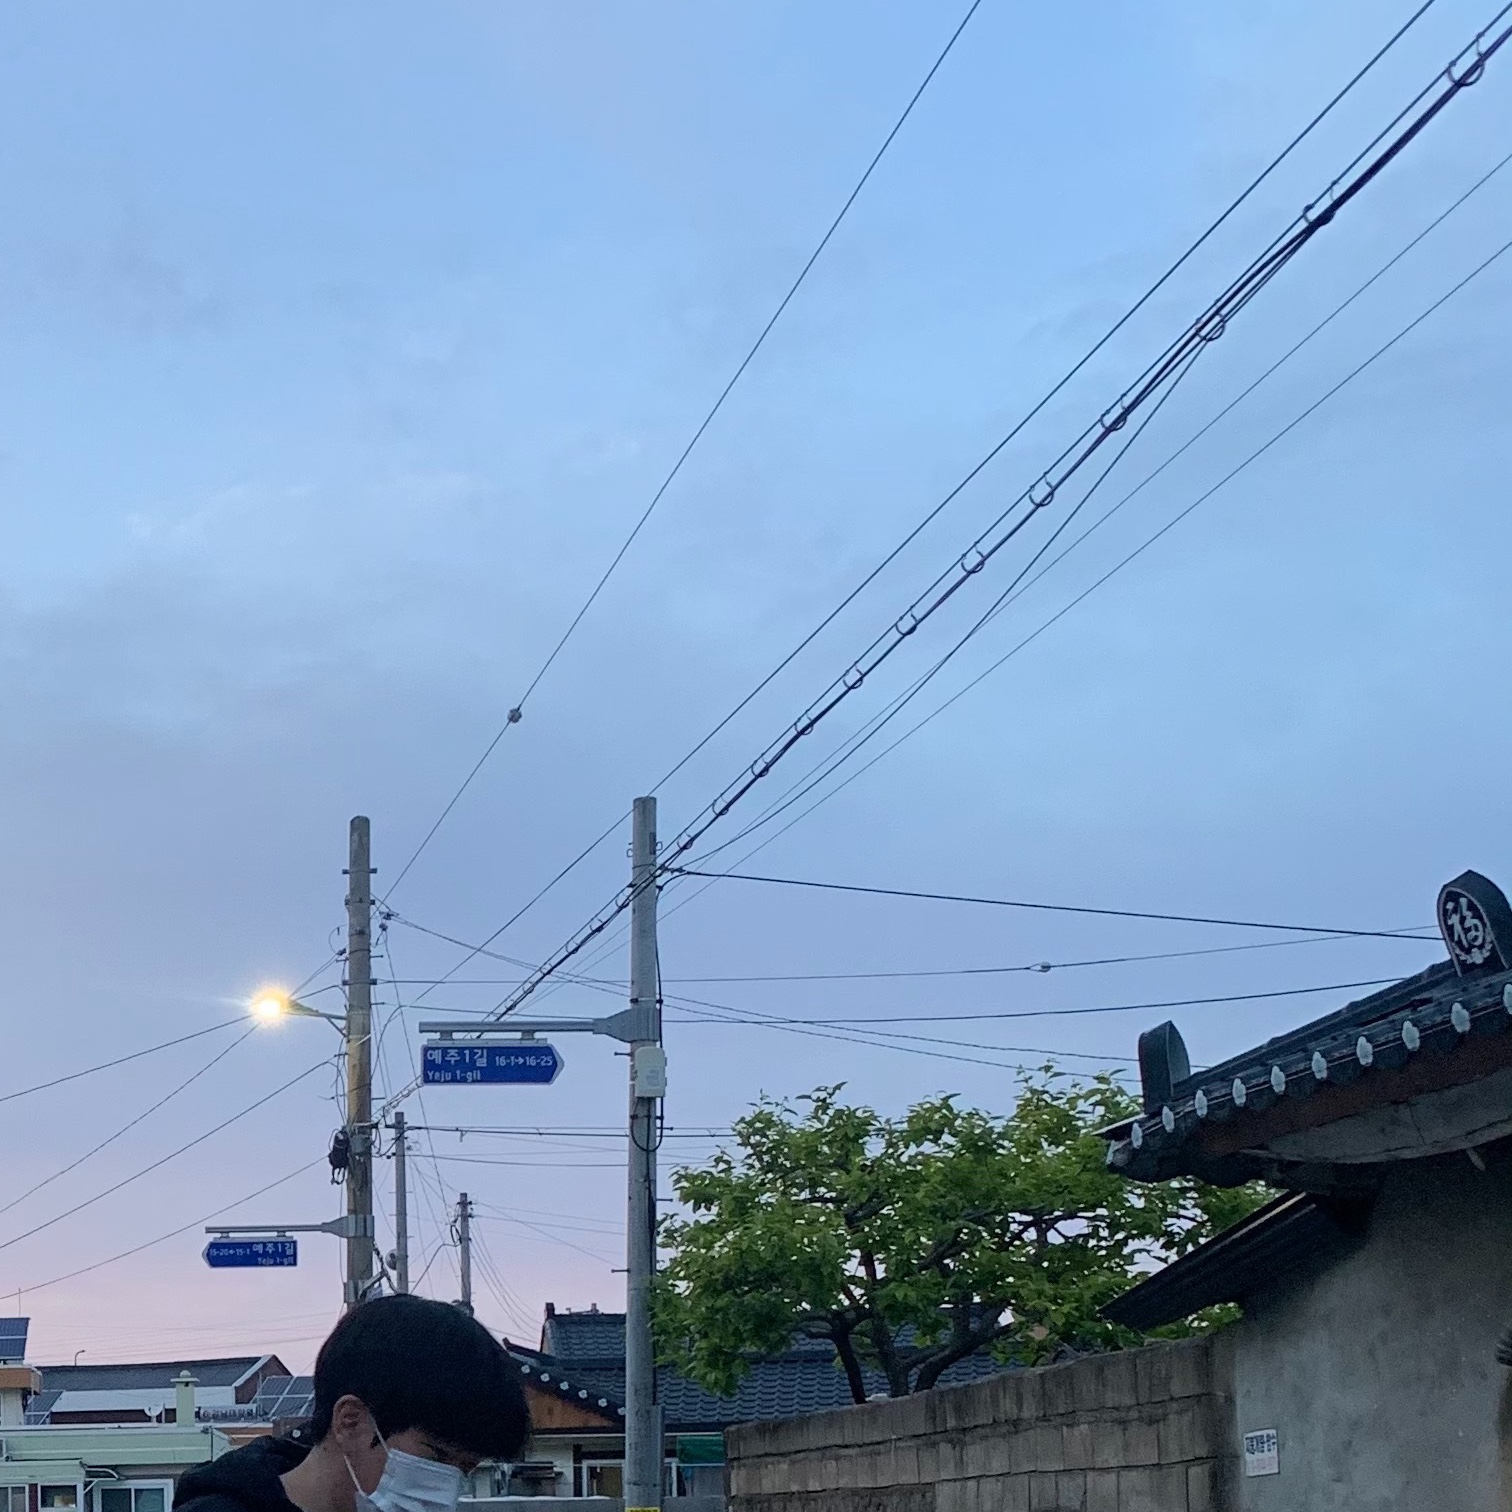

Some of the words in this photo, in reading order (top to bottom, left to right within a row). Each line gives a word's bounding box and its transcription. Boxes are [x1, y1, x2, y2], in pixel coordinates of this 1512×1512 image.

[1445, 896, 1484, 949] 福
[426, 1048, 488, 1067] 예주1길
[525, 1055, 554, 1067] 16-25
[427, 1070, 452, 1083] Yeju
[455, 1069, 482, 1083] 1-gil
[252, 1243, 294, 1255] 예주1길
